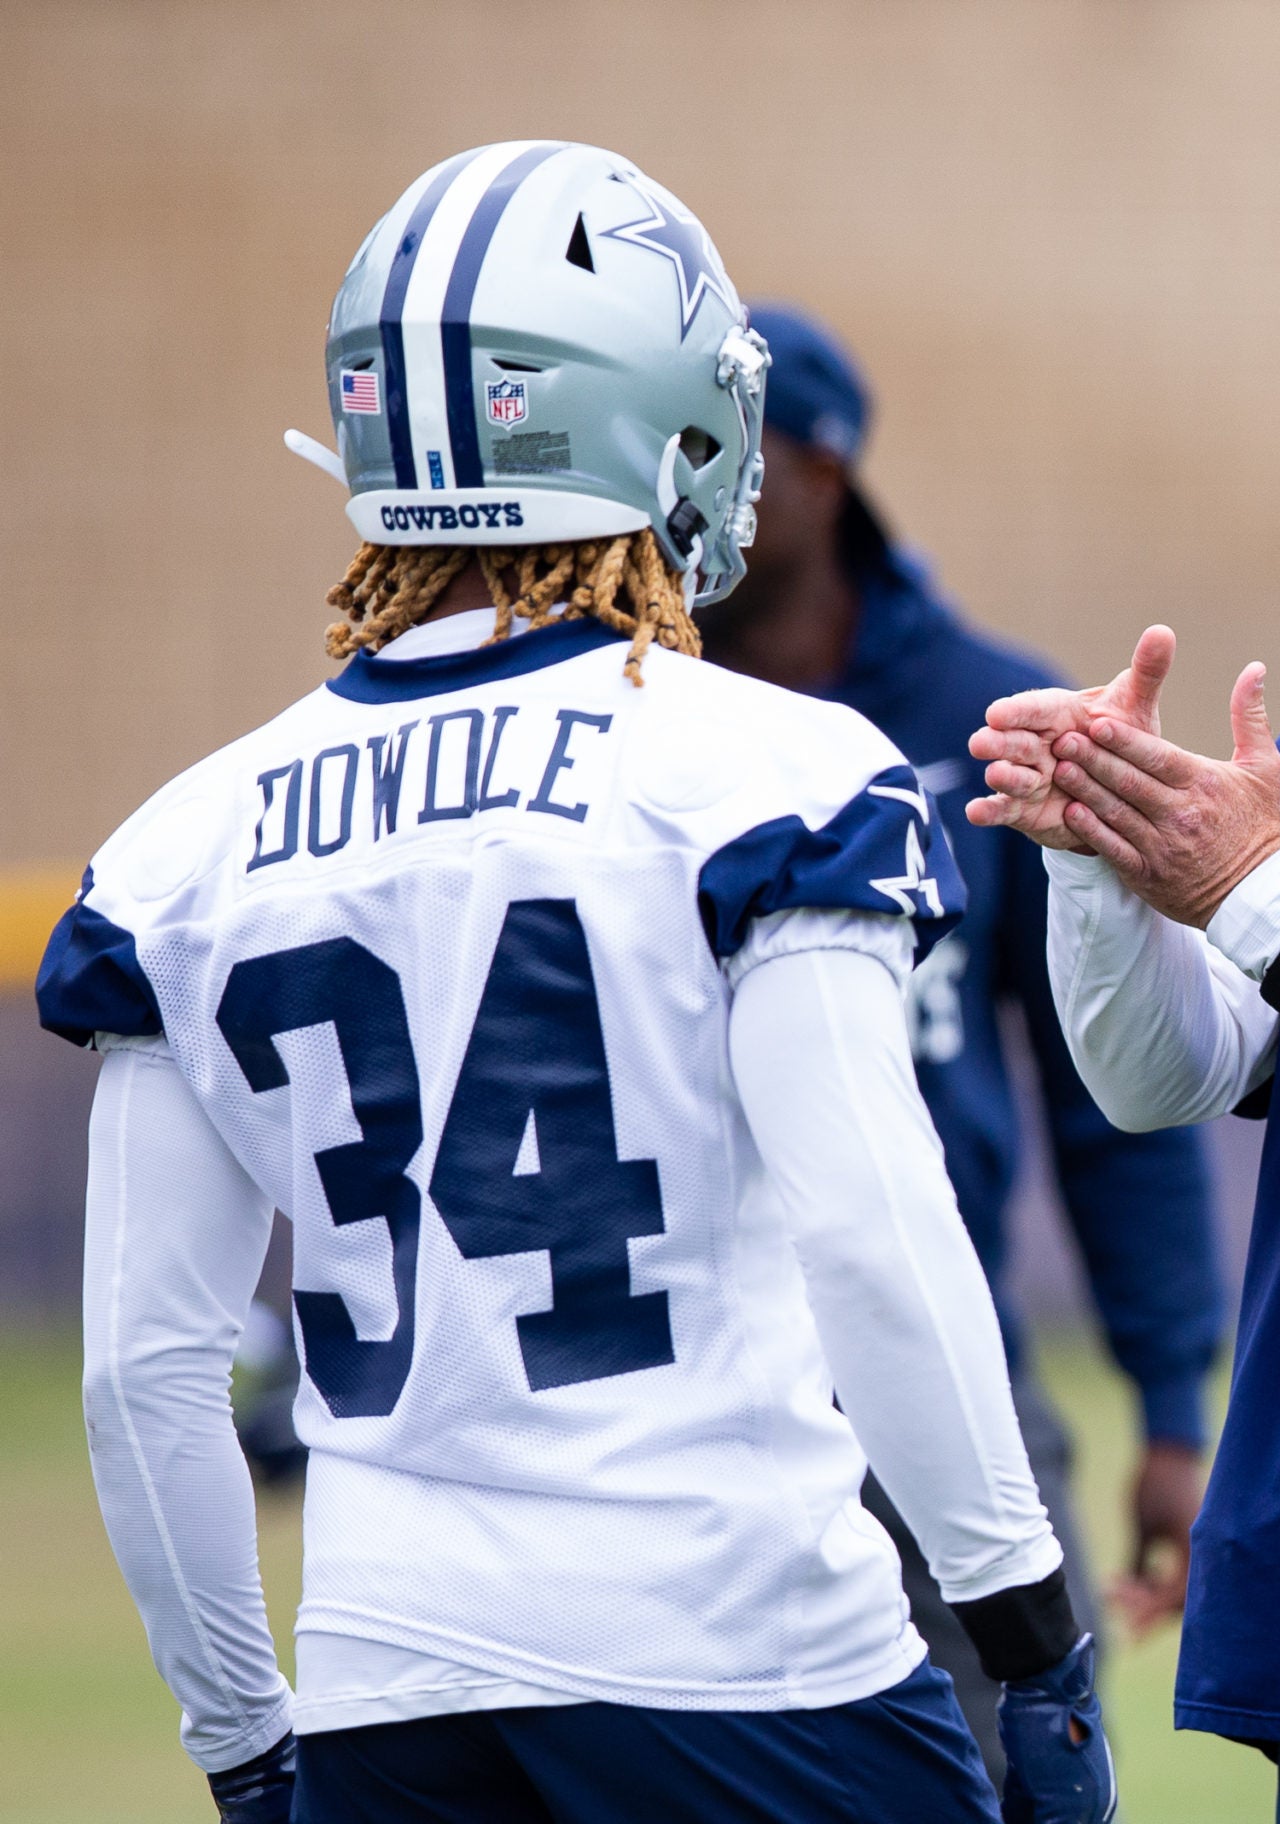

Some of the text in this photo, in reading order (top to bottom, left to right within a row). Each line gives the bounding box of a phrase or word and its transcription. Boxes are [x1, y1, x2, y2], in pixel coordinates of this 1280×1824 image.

[493, 399, 523, 420] NFL
[380, 502, 525, 531] COWBOYS
[246, 706, 613, 873] DOWDLE
[214, 897, 676, 1418] 34
